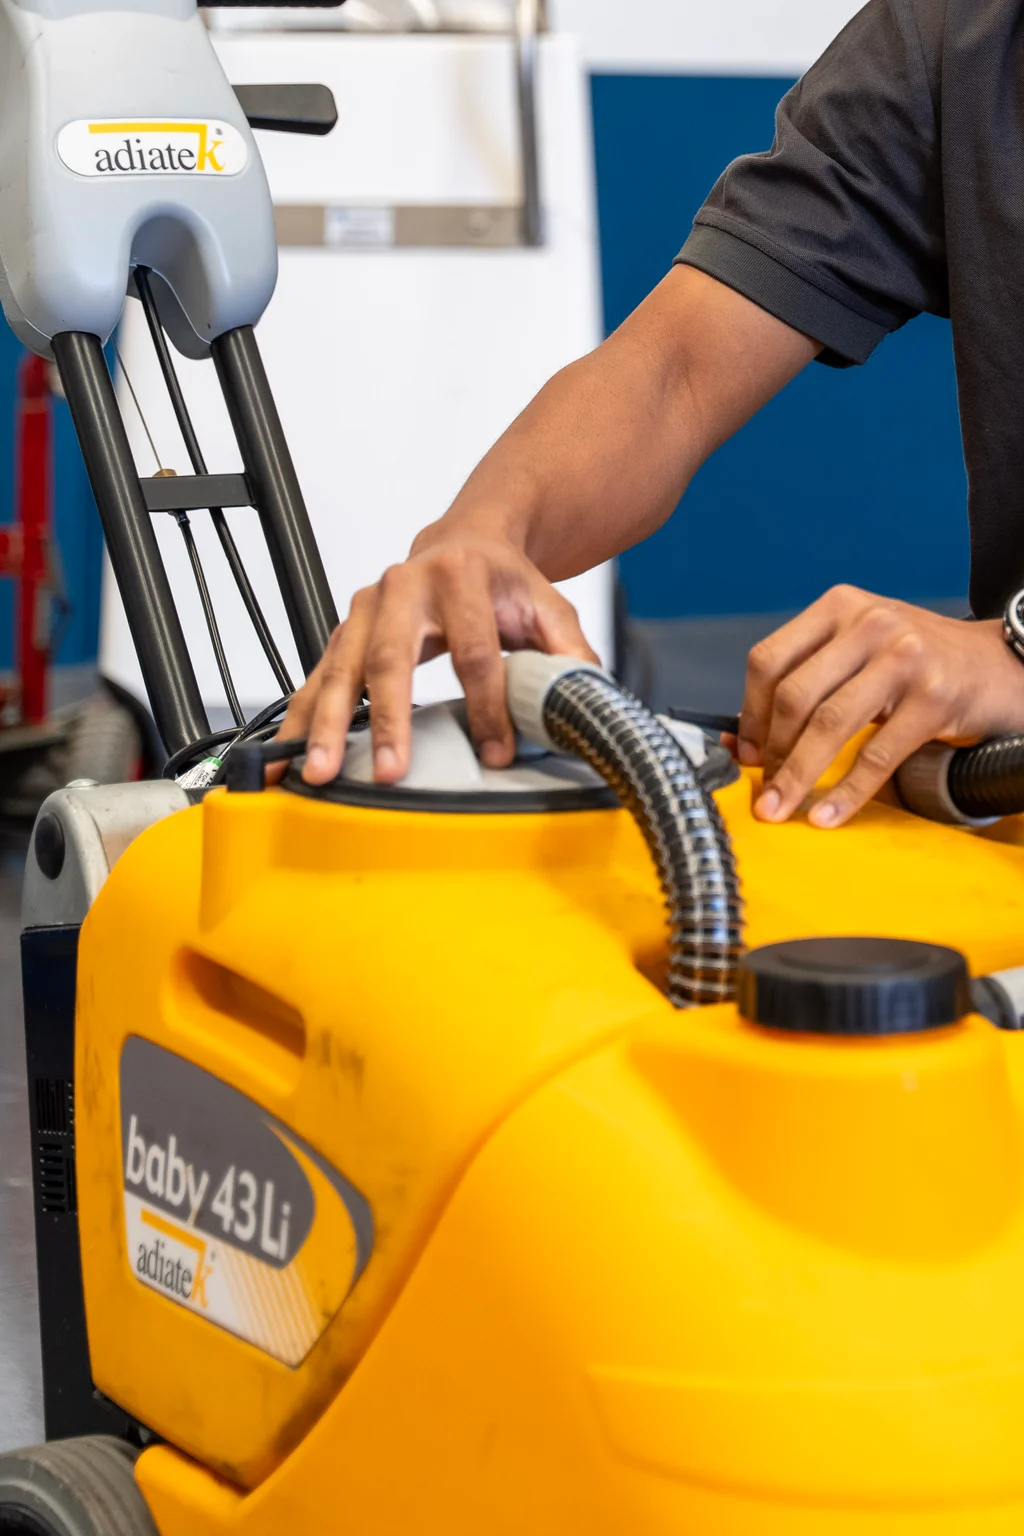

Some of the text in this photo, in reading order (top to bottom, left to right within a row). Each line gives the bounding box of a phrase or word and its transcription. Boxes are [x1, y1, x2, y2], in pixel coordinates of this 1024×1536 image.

[94, 123, 226, 172] adiatek
[126, 1114, 291, 1260] baby 43 Li
[137, 1238, 214, 1308] adiatek
